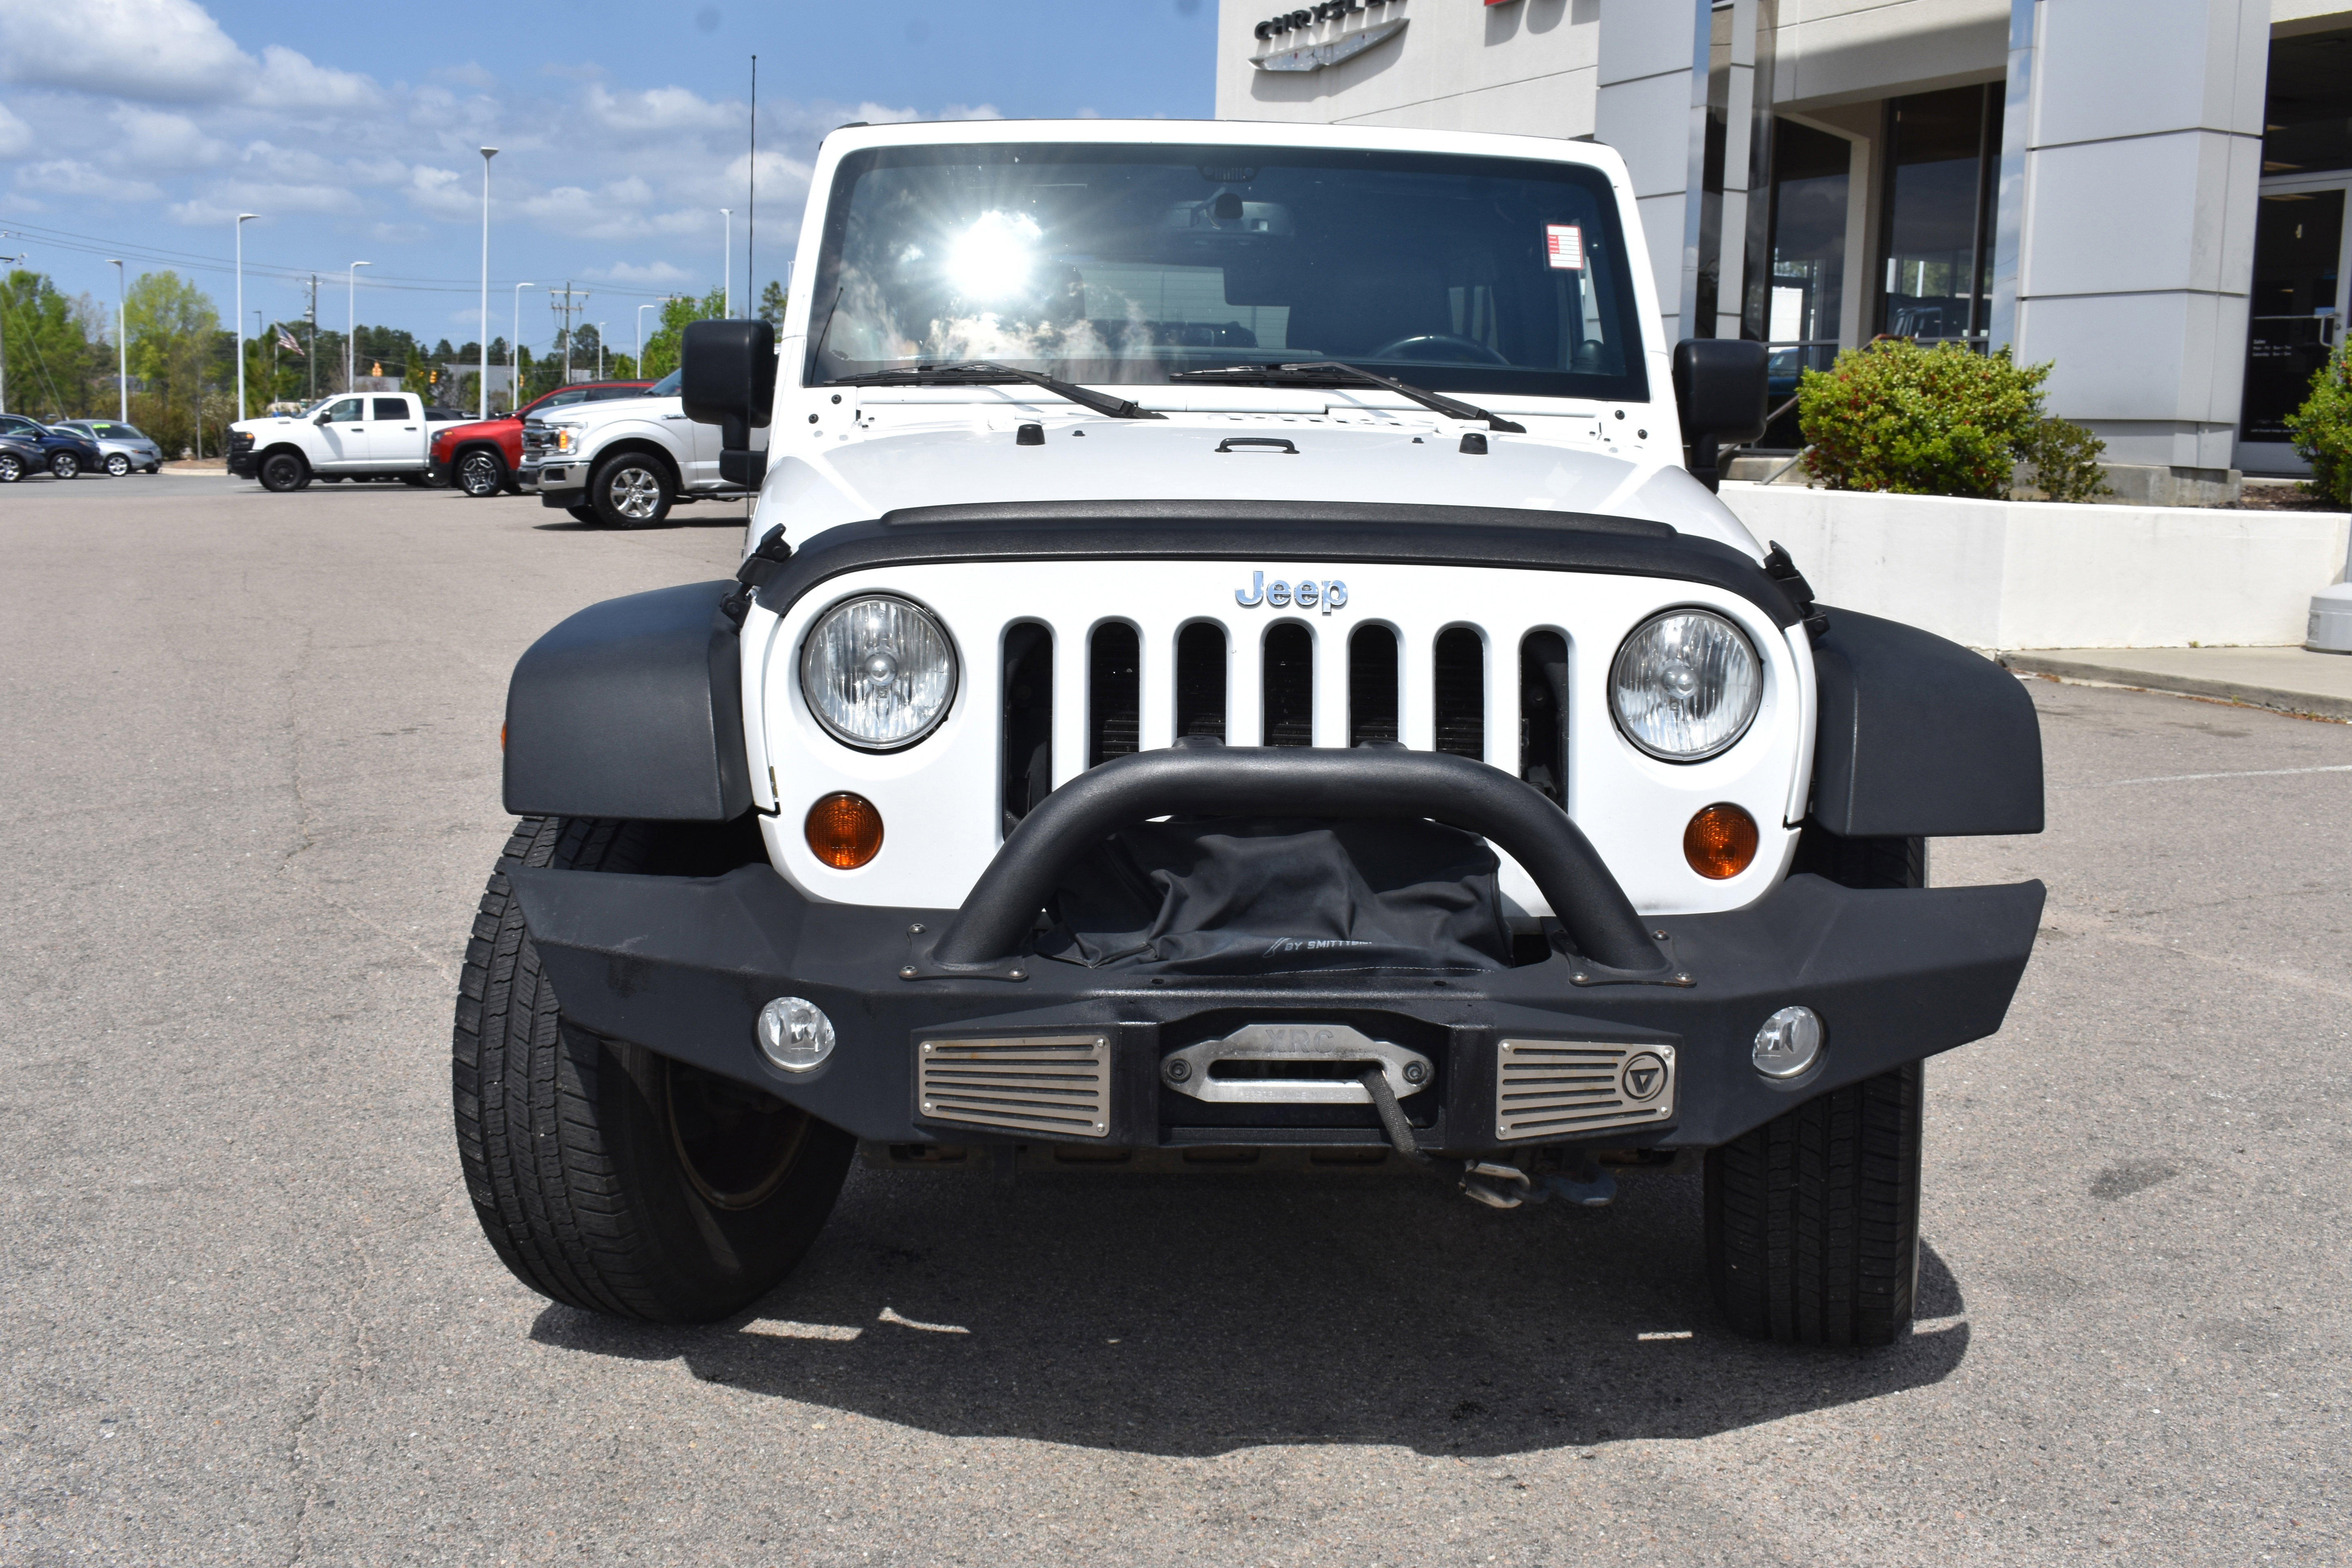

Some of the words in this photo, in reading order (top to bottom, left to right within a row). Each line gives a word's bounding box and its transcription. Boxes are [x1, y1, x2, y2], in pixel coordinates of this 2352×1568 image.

[1234, 571, 1348, 616] Jeep
[1284, 942, 1303, 951] BY
[1265, 1029, 1334, 1053] XRC
